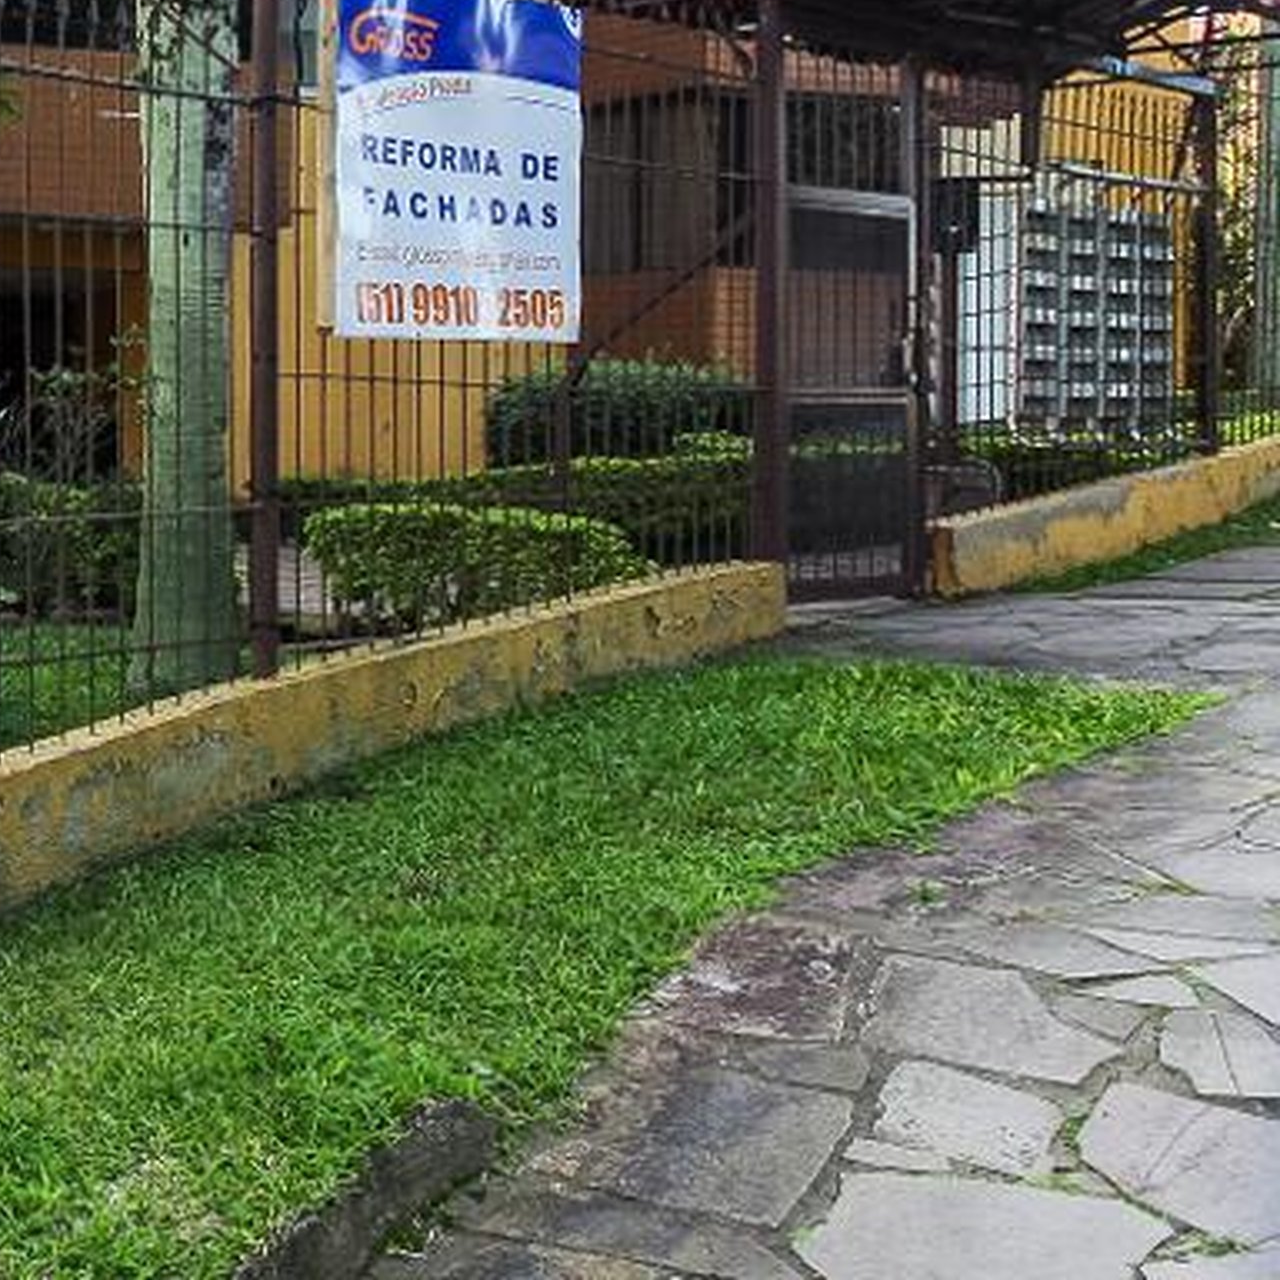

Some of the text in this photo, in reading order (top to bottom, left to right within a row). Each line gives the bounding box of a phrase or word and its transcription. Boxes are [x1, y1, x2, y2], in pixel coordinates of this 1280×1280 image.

[362, 133, 559, 181] REFORMA DE
[363, 187, 558, 229] FACHADAS
[498, 287, 564, 328] 2505
